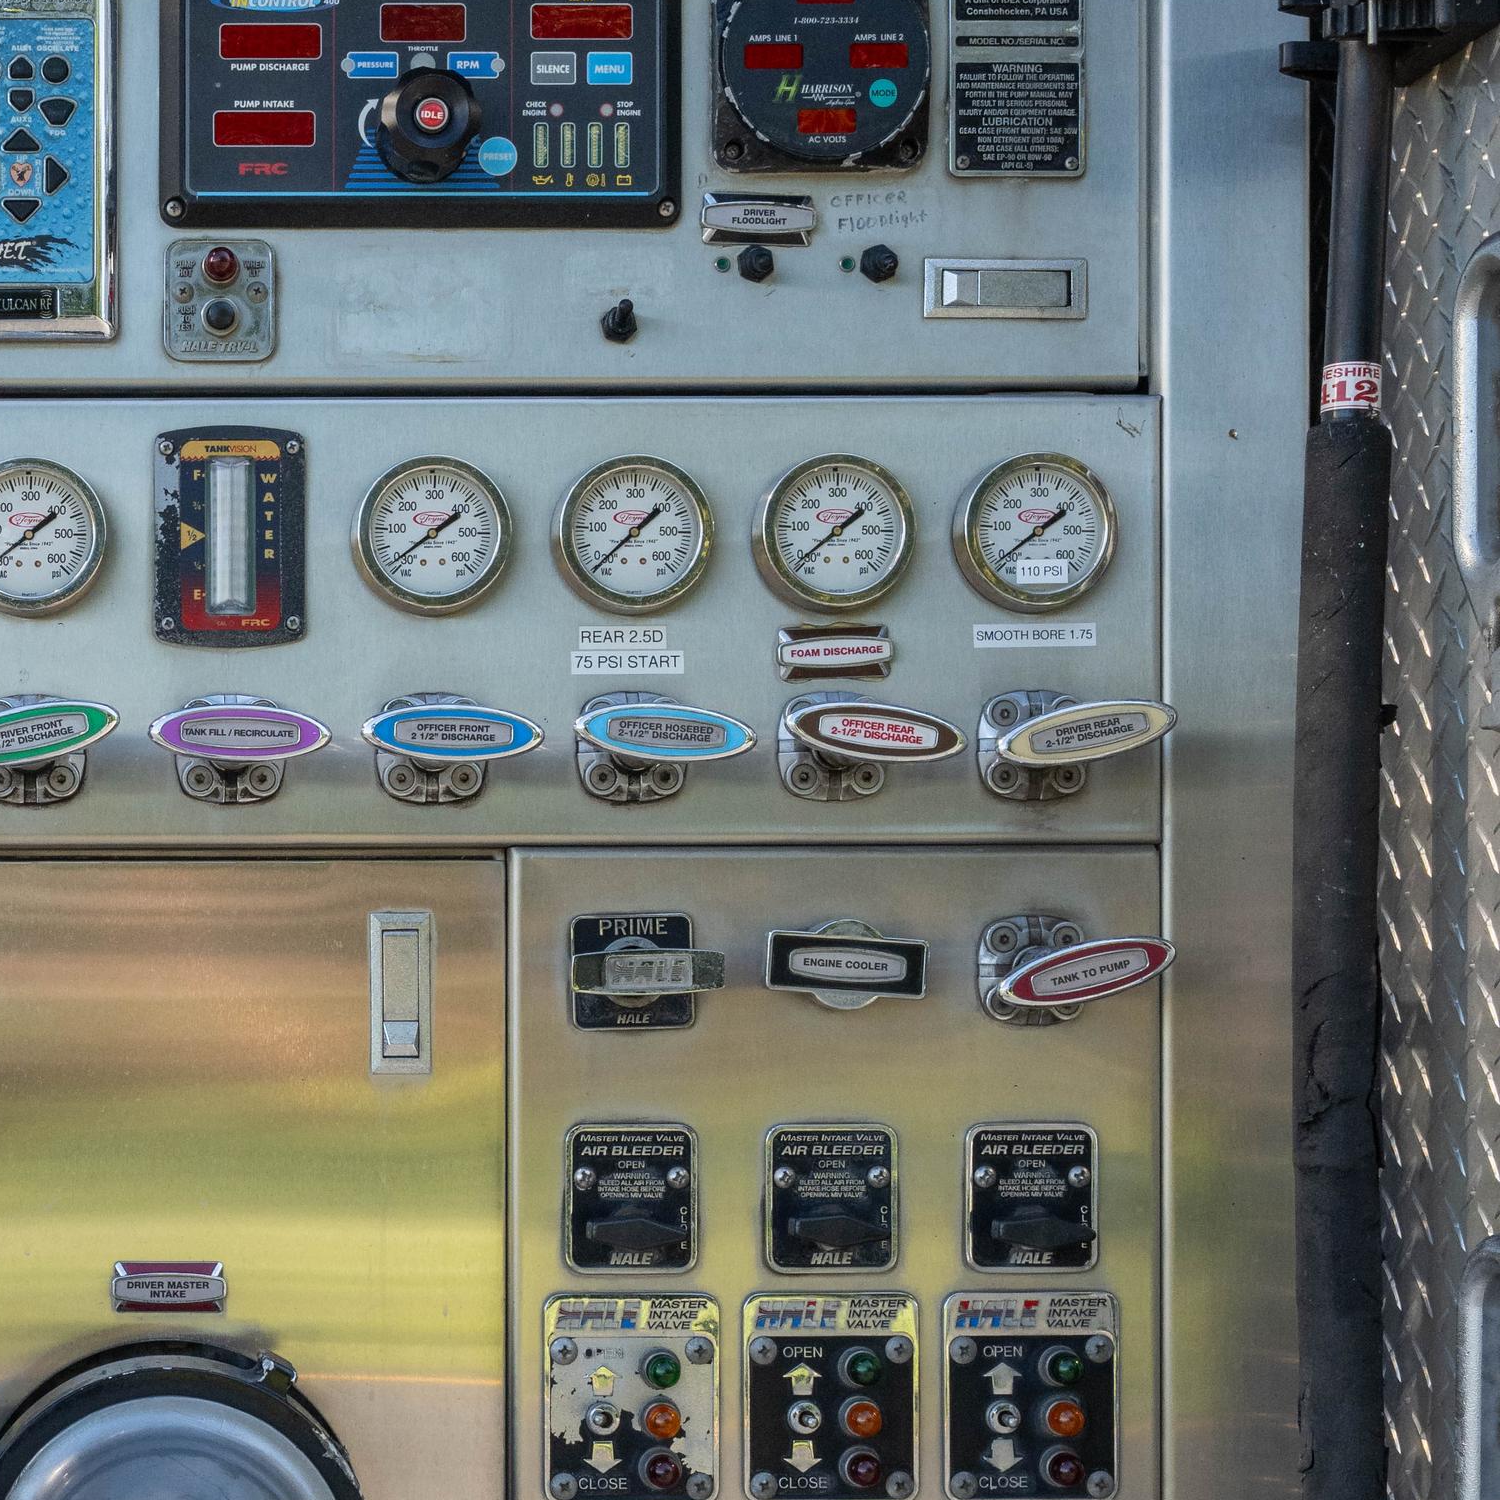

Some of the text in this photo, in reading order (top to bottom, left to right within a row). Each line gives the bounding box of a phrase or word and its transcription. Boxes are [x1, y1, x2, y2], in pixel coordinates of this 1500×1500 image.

[231, 62, 310, 71] PUMP DISCHARGE
[456, 60, 480, 70] RPM
[536, 65, 569, 74] SILENCE
[594, 65, 624, 74] MENU
[992, 64, 1043, 73] WARNING
[802, 84, 852, 94] HARRISON
[234, 100, 294, 108] PUMP INTAKE
[421, 111, 443, 120] IDLE
[983, 117, 1052, 126] LUBRICATION
[239, 163, 288, 175] FRC
[744, 209, 775, 217] DRIVER
[732, 217, 787, 225] FLOODLIGHT
[40, 299, 52, 312] RF
[205, 445, 256, 453] TANKVISION
[22, 491, 40, 501] 300
[259, 474, 277, 559] WATER
[54, 528, 73, 538] 500
[1021, 566, 1063, 577] 110 PSI
[581, 630, 664, 643] REAR 2.5D
[976, 628, 1093, 641] SMOOTH BORE 1.75
[575, 654, 680, 668] 75 PSI START
[31, 720, 63, 733] FRONT
[620, 721, 714, 734] OFFICER HOSEBED
[19, 726, 74, 745] DISCHARGE
[234, 729, 293, 738] RECIRCULATE
[618, 729, 710, 742] 2-1/2" DISCHARGE
[599, 918, 667, 936] PRIME
[804, 958, 889, 972] ENGINE COOLER
[1052, 960, 1130, 986] TANK TO PUMP
[582, 1146, 684, 1155] AIR BLEEDER
[983, 1346, 1022, 1357] OPEN
[578, 1478, 627, 1490] CLOSE
